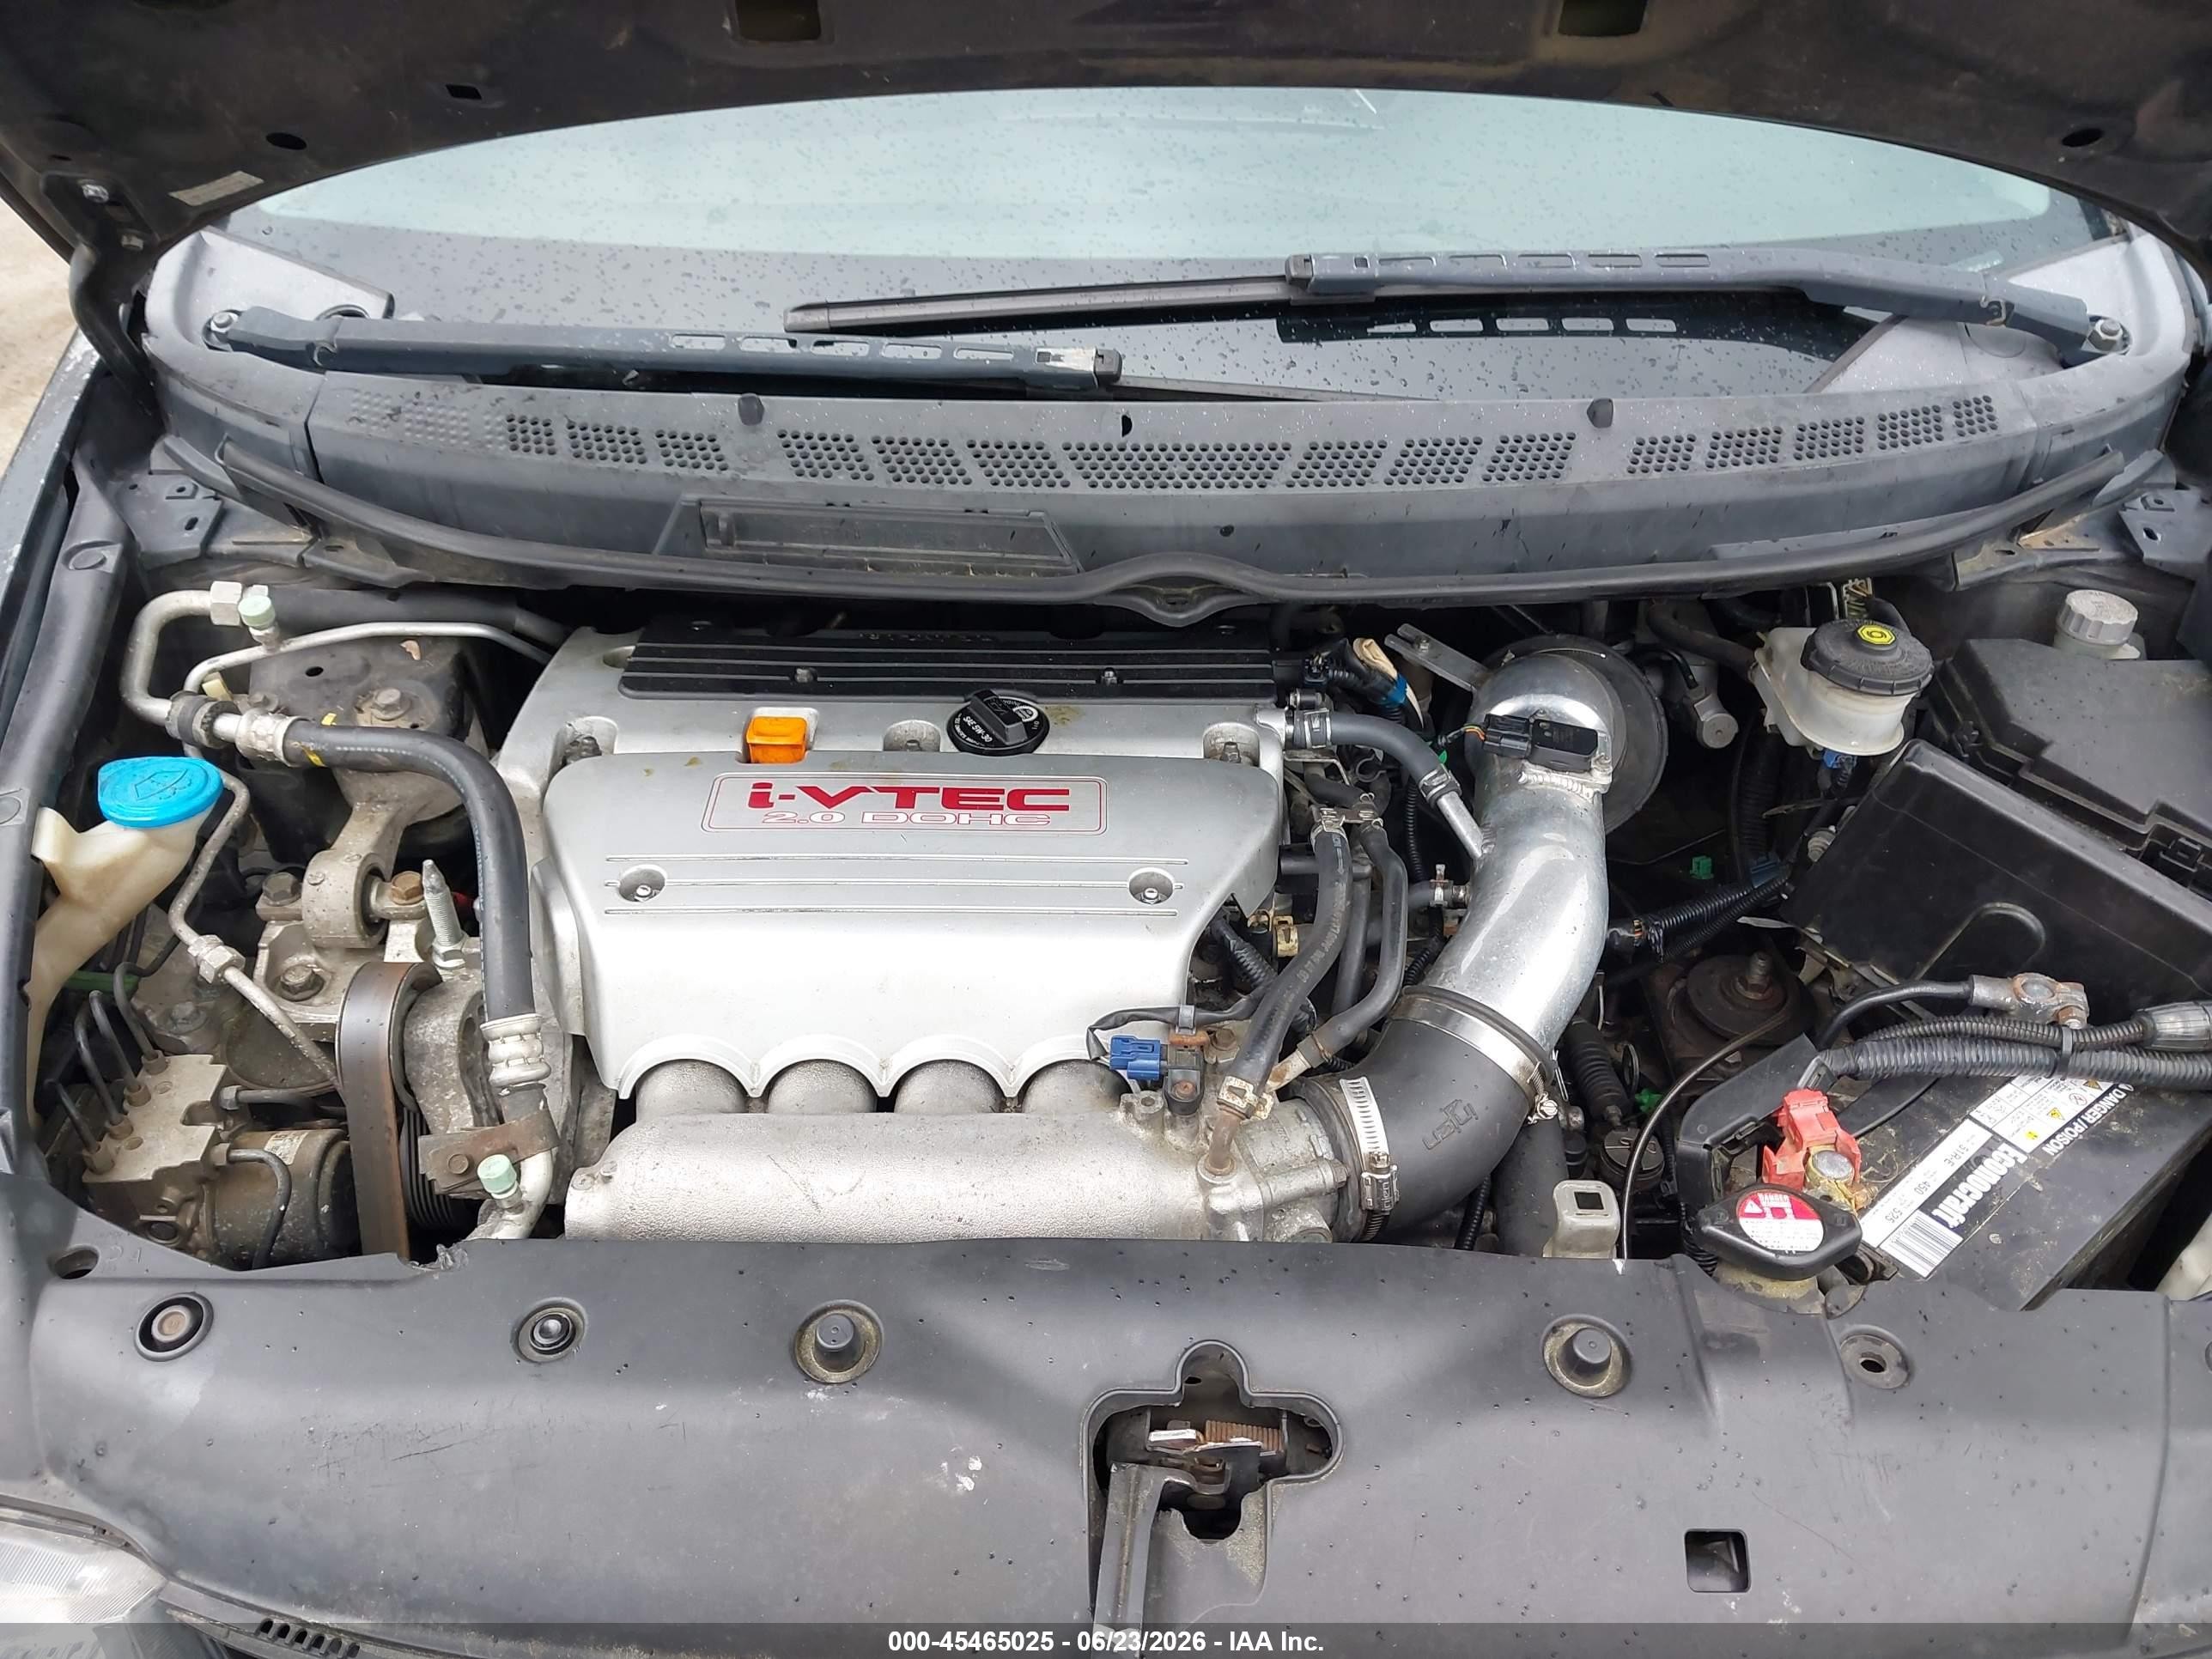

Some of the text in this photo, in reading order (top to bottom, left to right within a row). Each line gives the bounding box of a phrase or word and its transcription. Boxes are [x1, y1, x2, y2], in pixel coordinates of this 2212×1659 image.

[972, 724, 993, 743] 5W-30
[748, 782, 1070, 811] i-VTEC
[763, 811, 1051, 825] 2.0 DOHC
[1914, 1181, 1931, 1195] 450
[1931, 1142, 2027, 1229] Econocraft
[1885, 1207, 1903, 1224] 525
